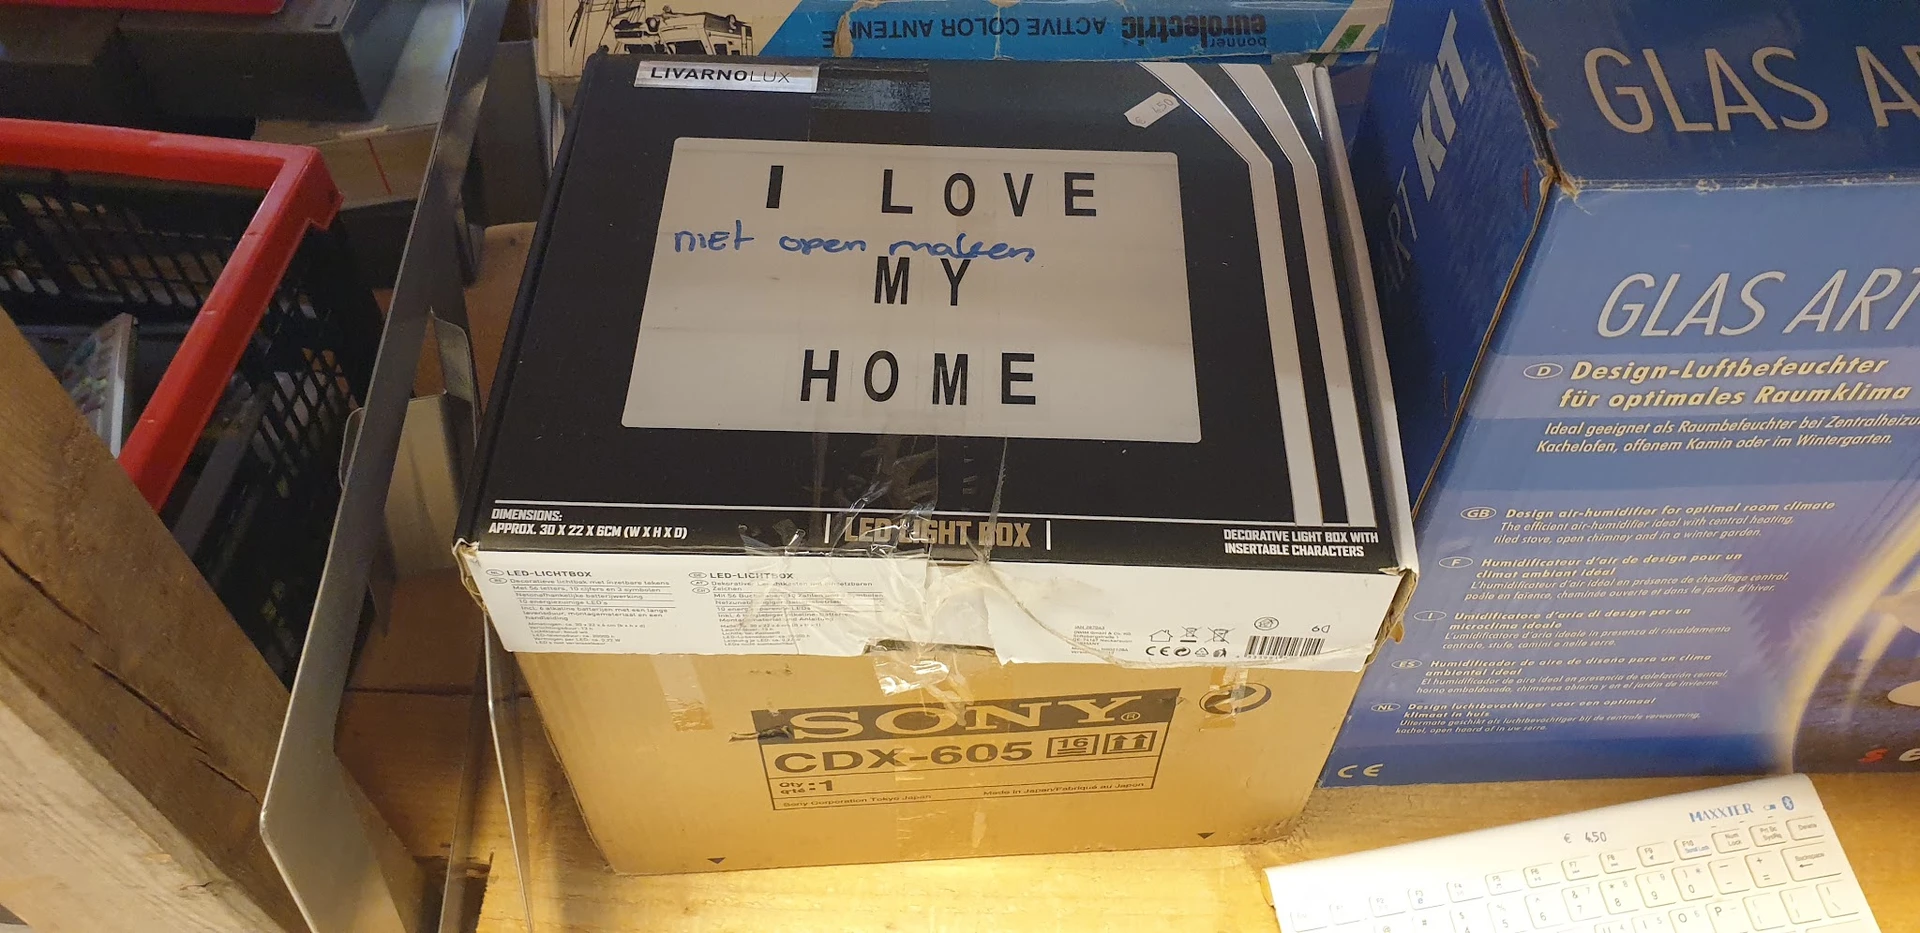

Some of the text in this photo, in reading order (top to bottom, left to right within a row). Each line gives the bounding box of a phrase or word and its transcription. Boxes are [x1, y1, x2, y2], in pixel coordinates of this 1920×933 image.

[941, 17, 1020, 37] COLOR
[1027, 16, 1107, 36] ACTIVE
[1121, 14, 1267, 49] eurolectric
[1210, 36, 1267, 48] bonner
[1584, 44, 1920, 134] GLAS A
[1412, 9, 1469, 201] KIT
[766, 165, 1097, 217] I LOVE
[778, 235, 867, 256] open
[874, 256, 971, 306] MY
[1597, 270, 1786, 338] GLAS
[800, 350, 1036, 405] HOME
[1570, 354, 1889, 384] Design-Luftbefeuchter
[1559, 382, 1912, 411] für optimales Raumklima
[1544, 413, 1920, 437] Ideal geeignet als Raumbefeuchter bei Zentralheizu
[1536, 433, 1892, 453] Kachelofen, offenem Kamin oder im Wintergarten.
[491, 508, 563, 521] DIMENSIONS:
[1505, 508, 1554, 521] Design
[1558, 505, 1658, 518] air-humidifier
[1661, 505, 1682, 515] for
[1685, 502, 1741, 517] optimal
[1743, 503, 1779, 512] room
[1783, 500, 1836, 511] climate
[489, 522, 688, 539] APPROX. 30 X 22 X 6CM (W X H X D)
[844, 516, 1031, 547] LED LIGHT BOX
[1501, 515, 1794, 531] The efficient air-humidifier ideal with central heating,
[1223, 529, 1378, 543] DECORATIVE LIGHT BOX WITH
[1493, 534, 1519, 543] tiled
[1521, 534, 1552, 544] stove,
[1556, 534, 1584, 544] open
[1586, 532, 1633, 542] chimney
[1635, 531, 1657, 540] and
[1659, 531, 1670, 540] in
[1683, 530, 1718, 539] winter
[1719, 528, 1761, 539] garden.
[1224, 542, 1364, 557] INSERTABLE CHARACTERS
[506, 570, 592, 578] LED-LICHTBOX
[789, 696, 1142, 740] SONY
[774, 738, 1089, 773] CDX-605 16
